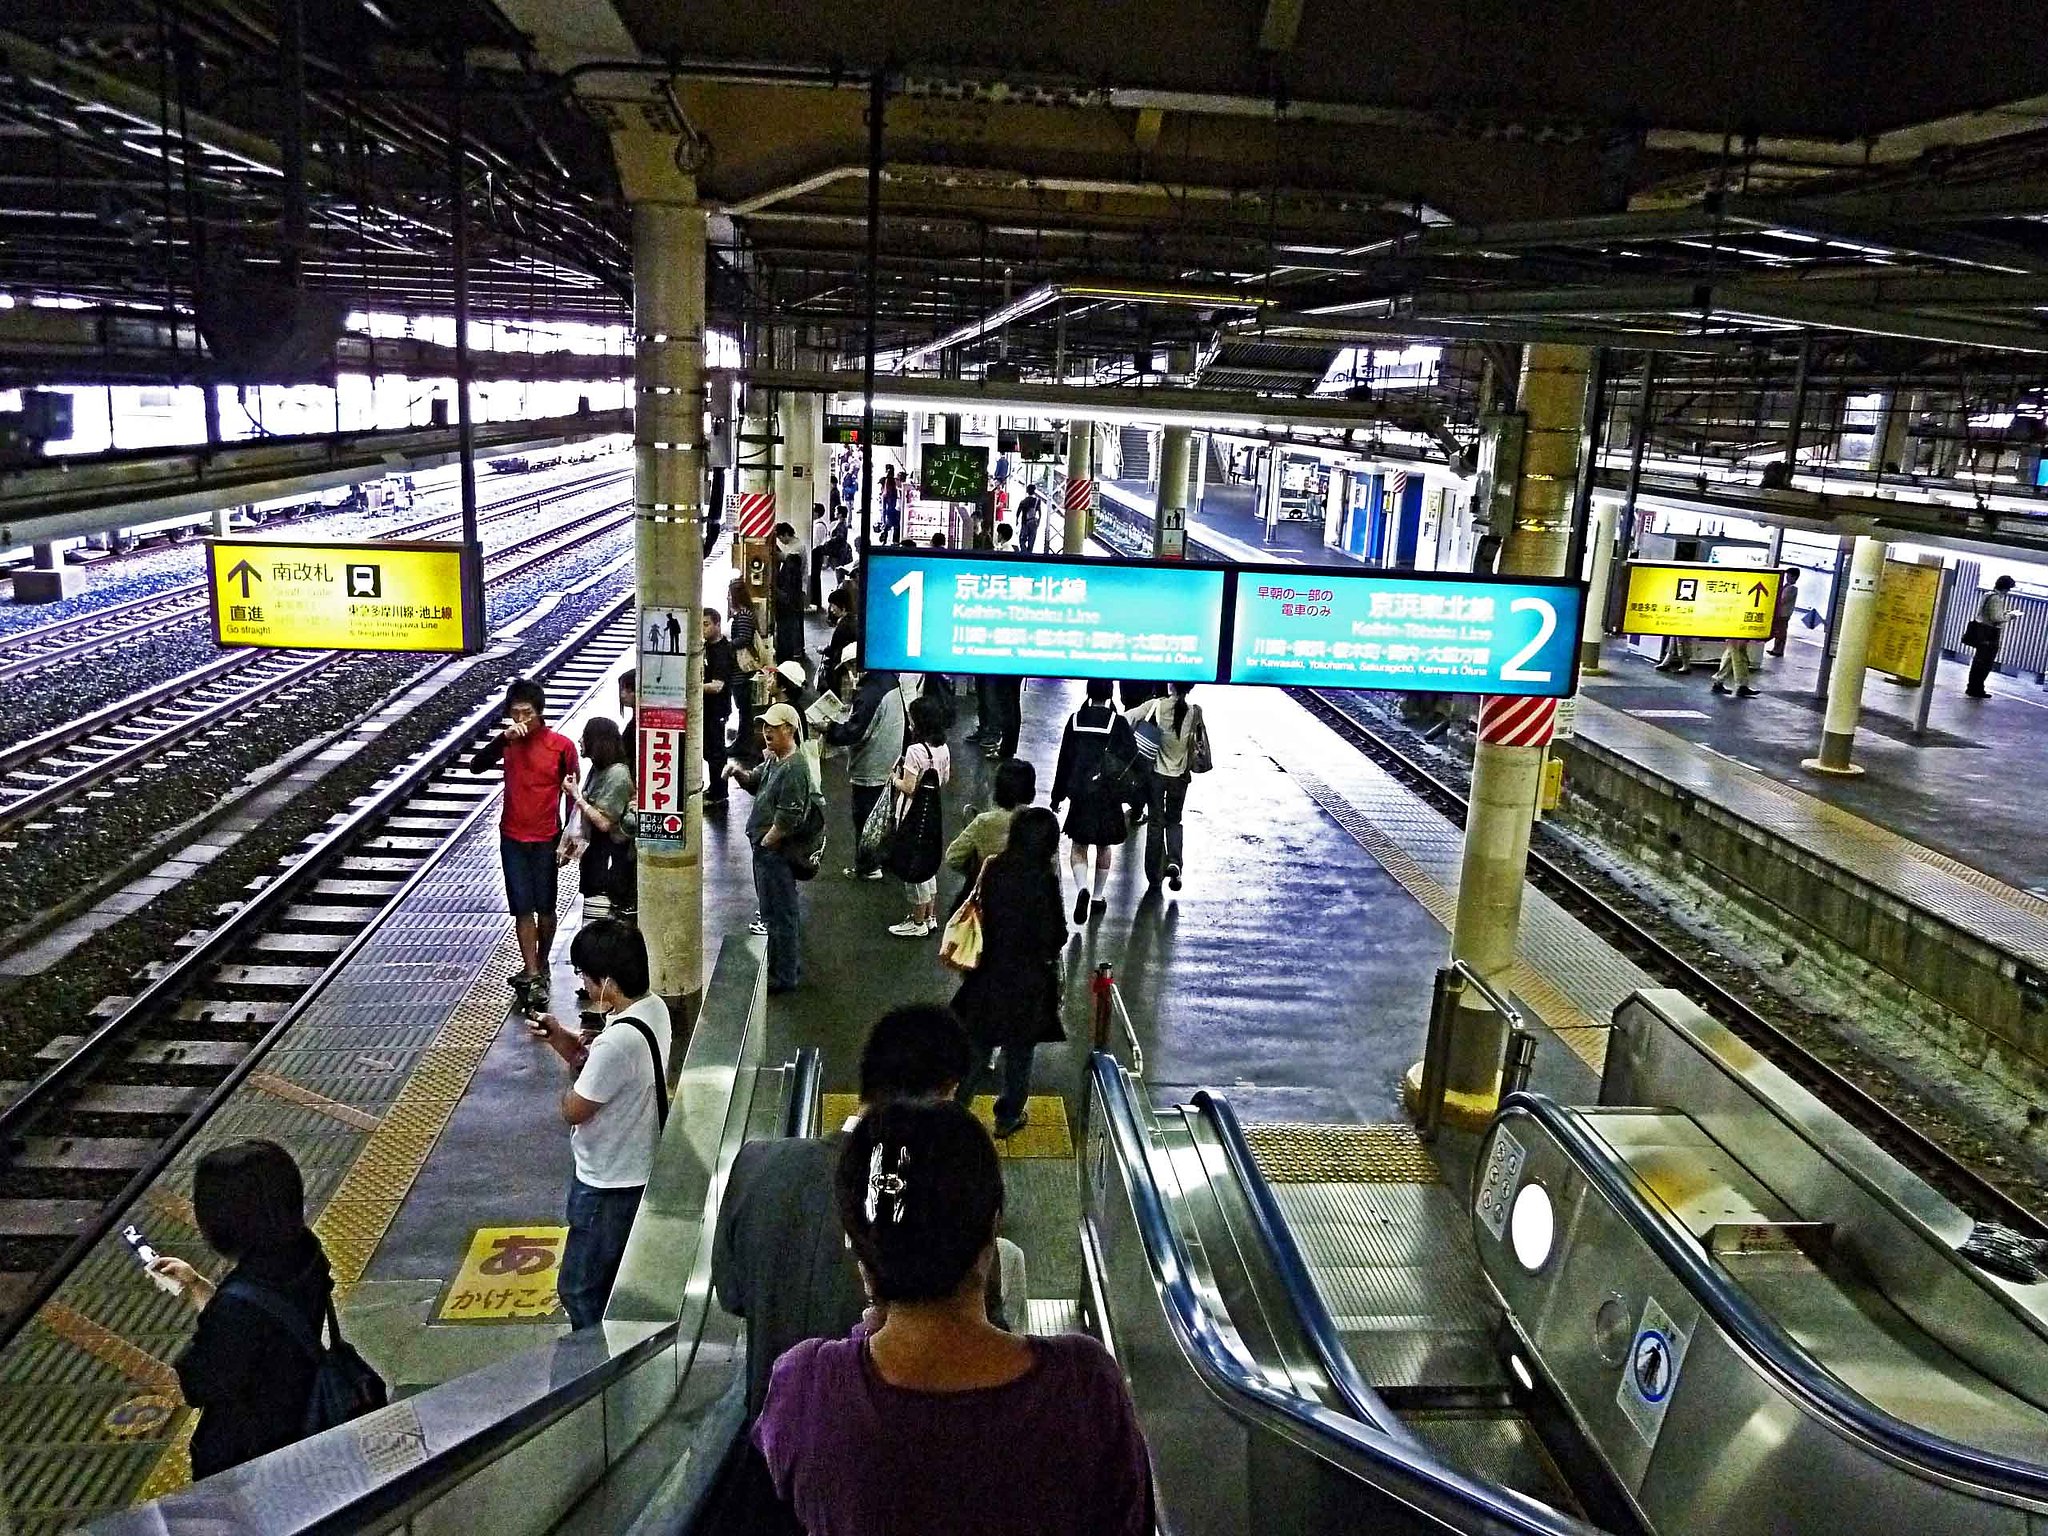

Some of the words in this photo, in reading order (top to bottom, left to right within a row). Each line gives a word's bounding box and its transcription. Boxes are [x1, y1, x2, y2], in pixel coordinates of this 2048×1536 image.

[272, 563, 334, 582] 南改札
[955, 573, 1086, 602] 京浜東北線
[1258, 587, 1333, 601] 早朝の一部の
[229, 605, 265, 621] 直進
[890, 571, 924, 657] 1
[1282, 603, 1331, 616] 電車のみ
[1369, 592, 1494, 622] 京浜東北線
[1066, 608, 1100, 624] Line
[226, 625, 239, 634] Go
[241, 626, 271, 636] straight
[1459, 625, 1492, 641] Line
[1500, 597, 1557, 682] 2
[1451, 665, 1458, 675] &
[480, 1235, 559, 1275] あ
